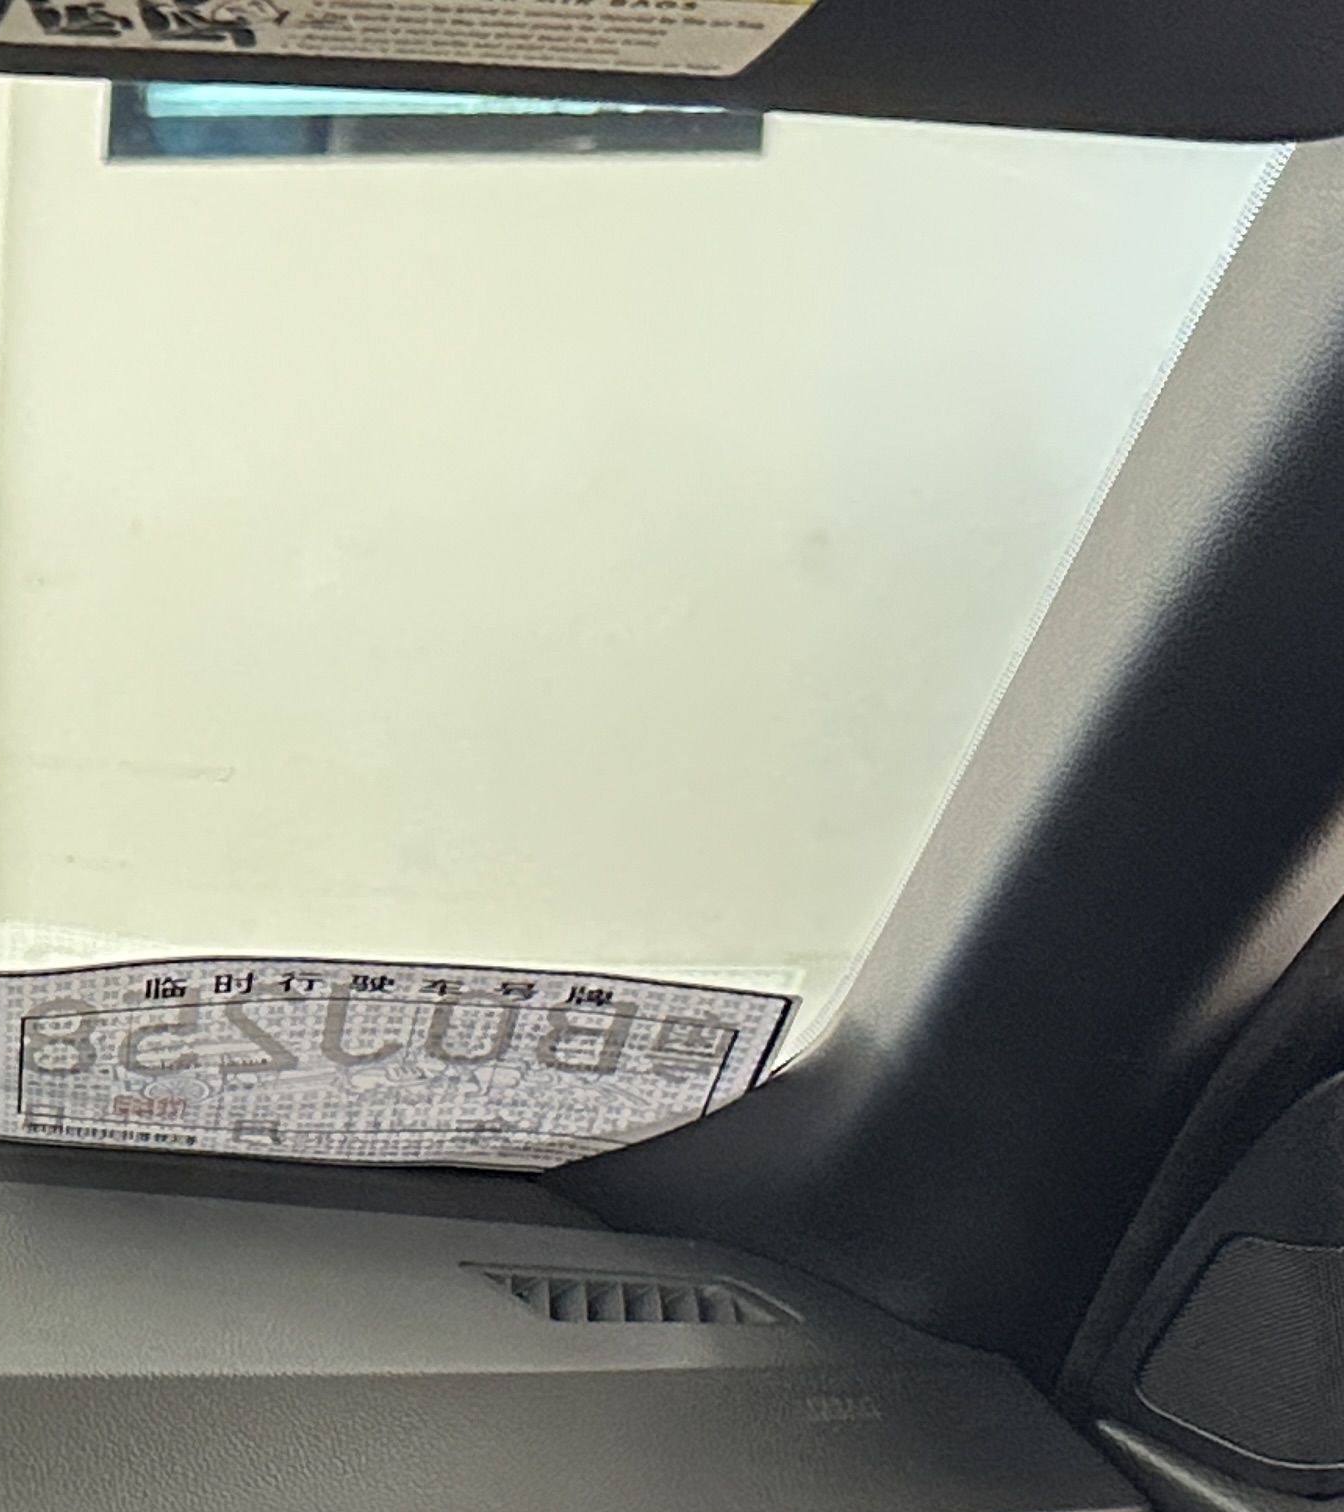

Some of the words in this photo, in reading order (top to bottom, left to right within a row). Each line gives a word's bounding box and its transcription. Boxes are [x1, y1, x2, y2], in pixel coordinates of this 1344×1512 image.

[144, 967, 613, 1006] 临时行驶车号牌
